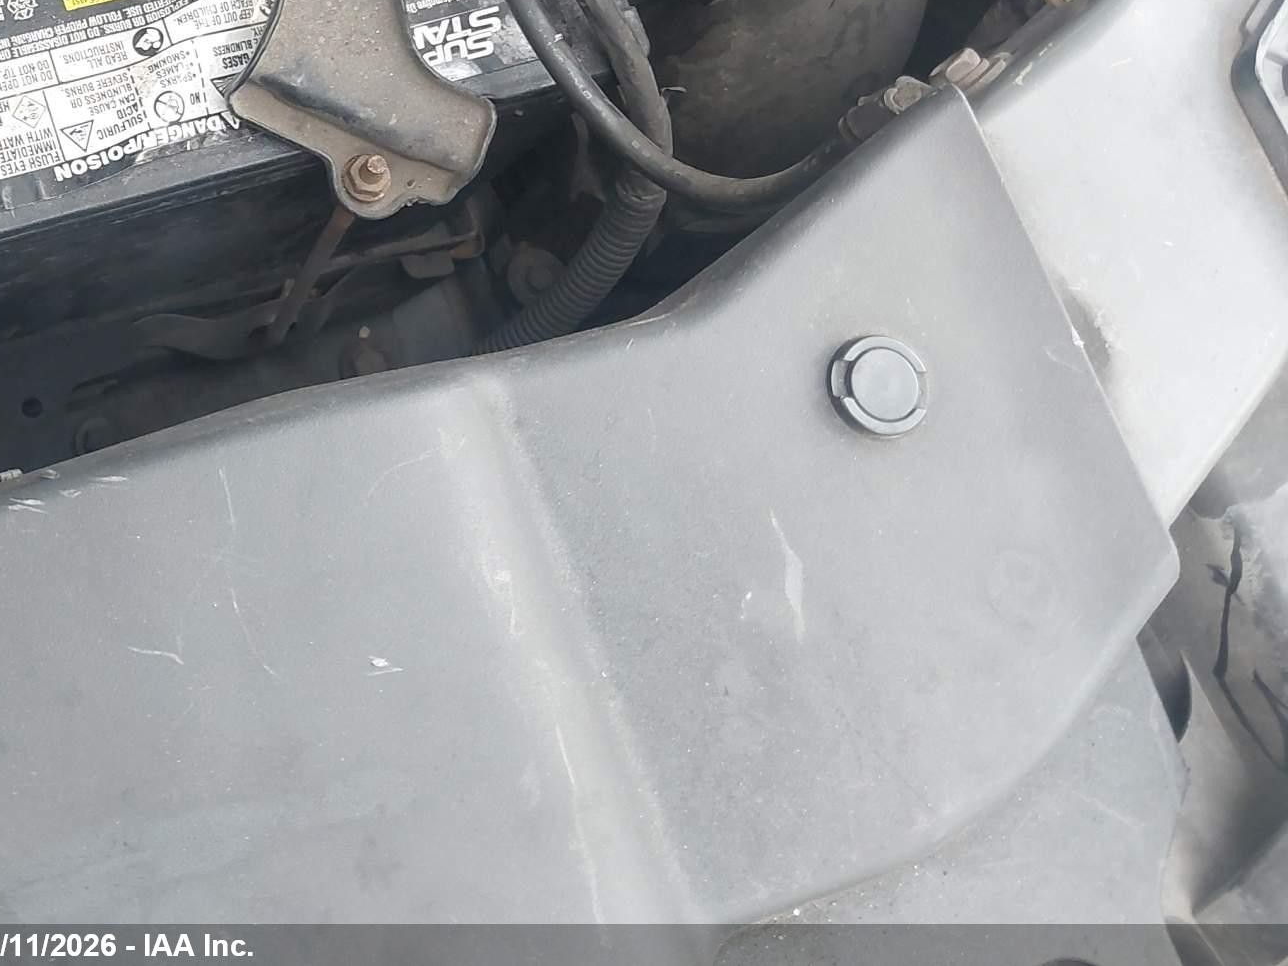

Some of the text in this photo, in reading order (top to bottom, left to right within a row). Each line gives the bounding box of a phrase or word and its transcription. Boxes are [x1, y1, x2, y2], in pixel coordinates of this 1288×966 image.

[218, 1, 229, 12] OF
[87, 10, 121, 25] FOLLOW
[132, 16, 145, 26] OR
[173, 4, 217, 25] CHILDREN.
[211, 14, 221, 25] OF
[222, 11, 237, 22] OUT
[53, 19, 87, 34] PROPER
[193, 18, 209, 29] THE
[10, 28, 53, 45] CHARGING
[69, 30, 86, 42] NOT
[86, 27, 100, 37] DO
[10, 35, 68, 56] DISASSEMBLE
[59, 41, 123, 63] INSTRUCTIONS.
[212, 40, 252, 55] BLINDNESS
[36, 59, 48, 69] DO
[87, 51, 127, 68] READ ALL
[220, 53, 250, 68] GASES
[18, 63, 35, 74] NOT
[40, 71, 52, 80] DO
[20, 74, 37, 85] NOT
[60, 73, 127, 97] SEVERE BURNS.
[70, 83, 131, 107] BLINDNESS OR
[189, 92, 201, 104] NO
[88, 93, 135, 115] CAN CAUSE
[116, 103, 138, 118] ACID
[96, 114, 142, 138] SULFURIC
[25, 128, 52, 142] WITH
[53, 115, 222, 180] DANGER/POISON
[0, 152, 59, 175] FLUSH EYES
